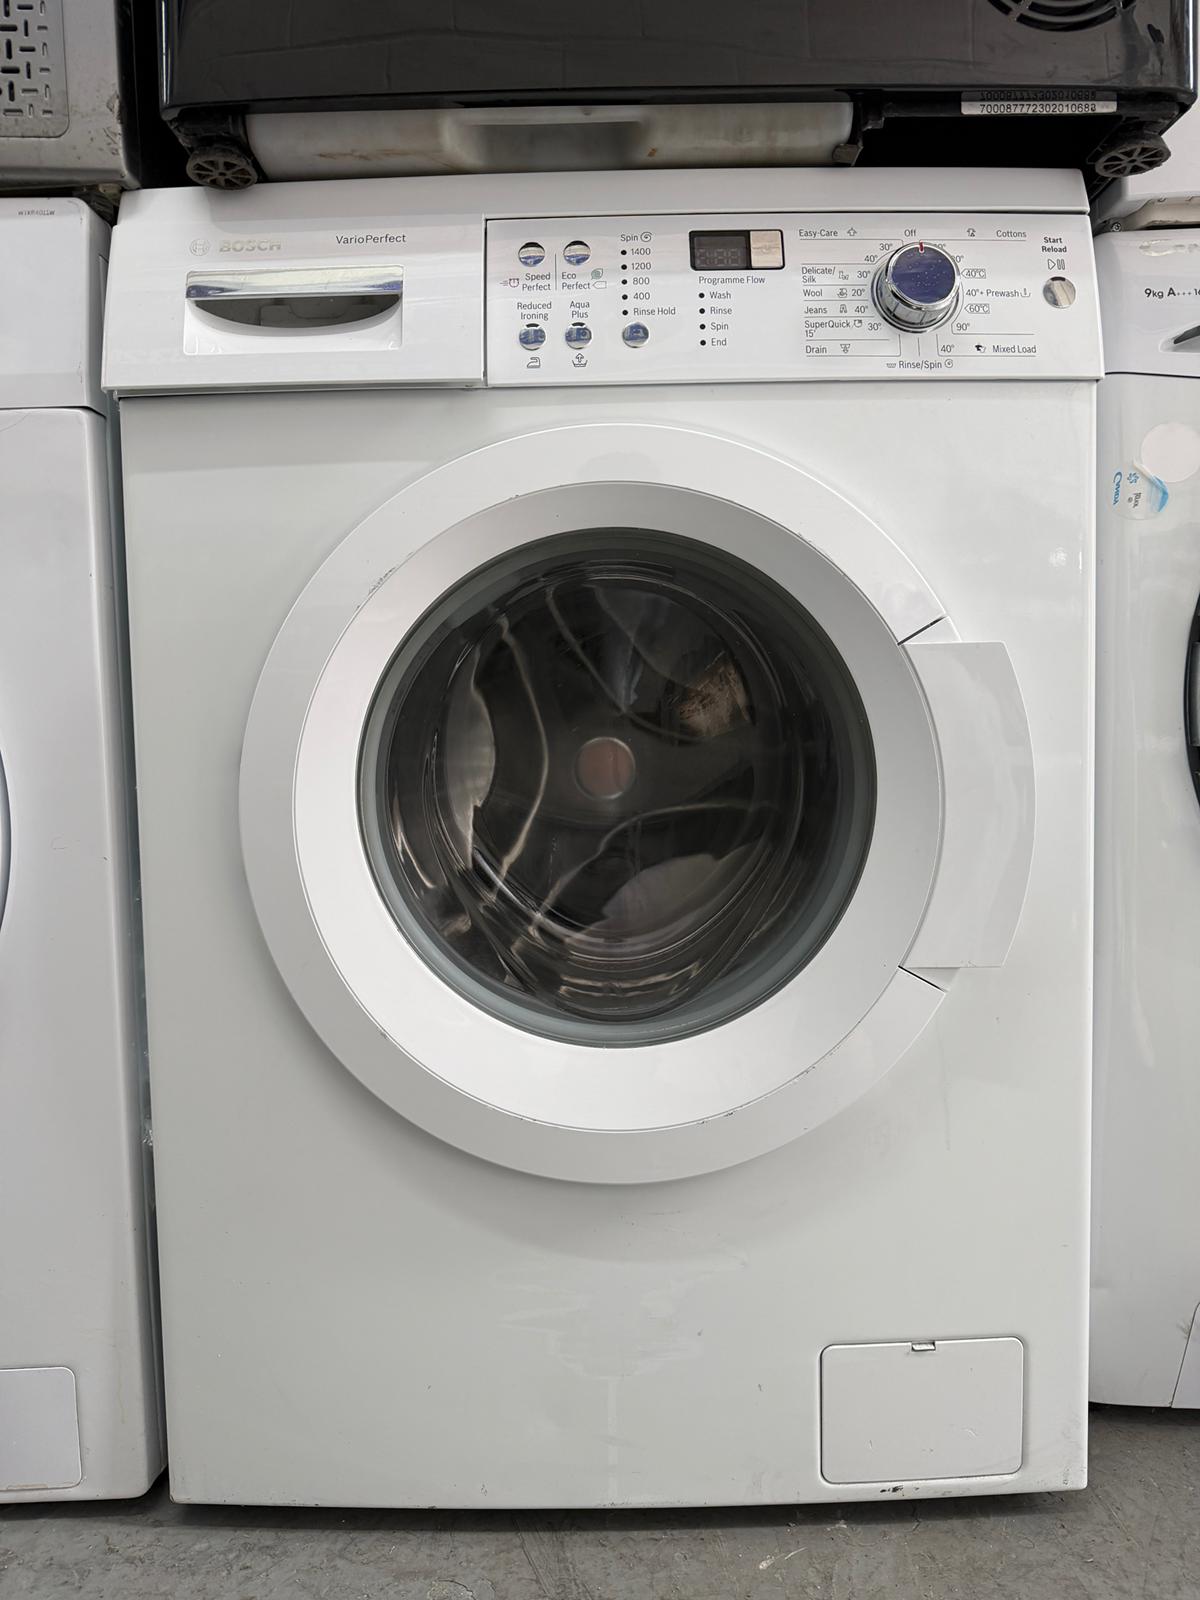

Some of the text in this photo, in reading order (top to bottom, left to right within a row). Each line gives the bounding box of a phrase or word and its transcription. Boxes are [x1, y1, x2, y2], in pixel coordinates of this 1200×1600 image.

[798, 229, 838, 238] Easy-Care
[904, 229, 916, 237] Off
[996, 230, 1027, 238] Cottons
[335, 233, 406, 245] VarioPerfect
[620, 234, 639, 242] Spin
[219, 239, 282, 253] BOSCH
[879, 243, 893, 251] 30°
[801, 266, 835, 275] Delicate/
[857, 270, 871, 279] 30°
[965, 269, 985, 278] 40°C
[524, 272, 550, 282] Speed
[561, 272, 576, 280] Eco
[698, 275, 766, 285] Programme Flow
[802, 275, 817, 283] Silk
[632, 277, 650, 285] 800
[562, 282, 591, 290] Perfect
[633, 292, 650, 300] 400
[710, 291, 732, 299] Wash
[802, 288, 823, 297] Wool
[851, 288, 866, 297] 20°
[986, 289, 1020, 298] Prewash
[516, 302, 552, 310] Reduced
[569, 301, 590, 310] Aqua
[710, 306, 732, 314] Rinse
[854, 306, 868, 314] 40°
[968, 304, 989, 313] 60°C
[571, 310, 589, 319] Plus
[633, 306, 676, 316] Rinse Hold
[520, 312, 549, 321] Ironing
[710, 322, 729, 332] Spin
[804, 320, 851, 330] SuperQuick
[867, 322, 882, 331] 30°
[956, 323, 970, 331] 90°
[711, 338, 727, 346] End
[805, 345, 827, 354] Drain
[940, 344, 955, 353] 40°
[992, 344, 1037, 353] Mixed Load
[898, 360, 942, 370] Rinse/Spin
